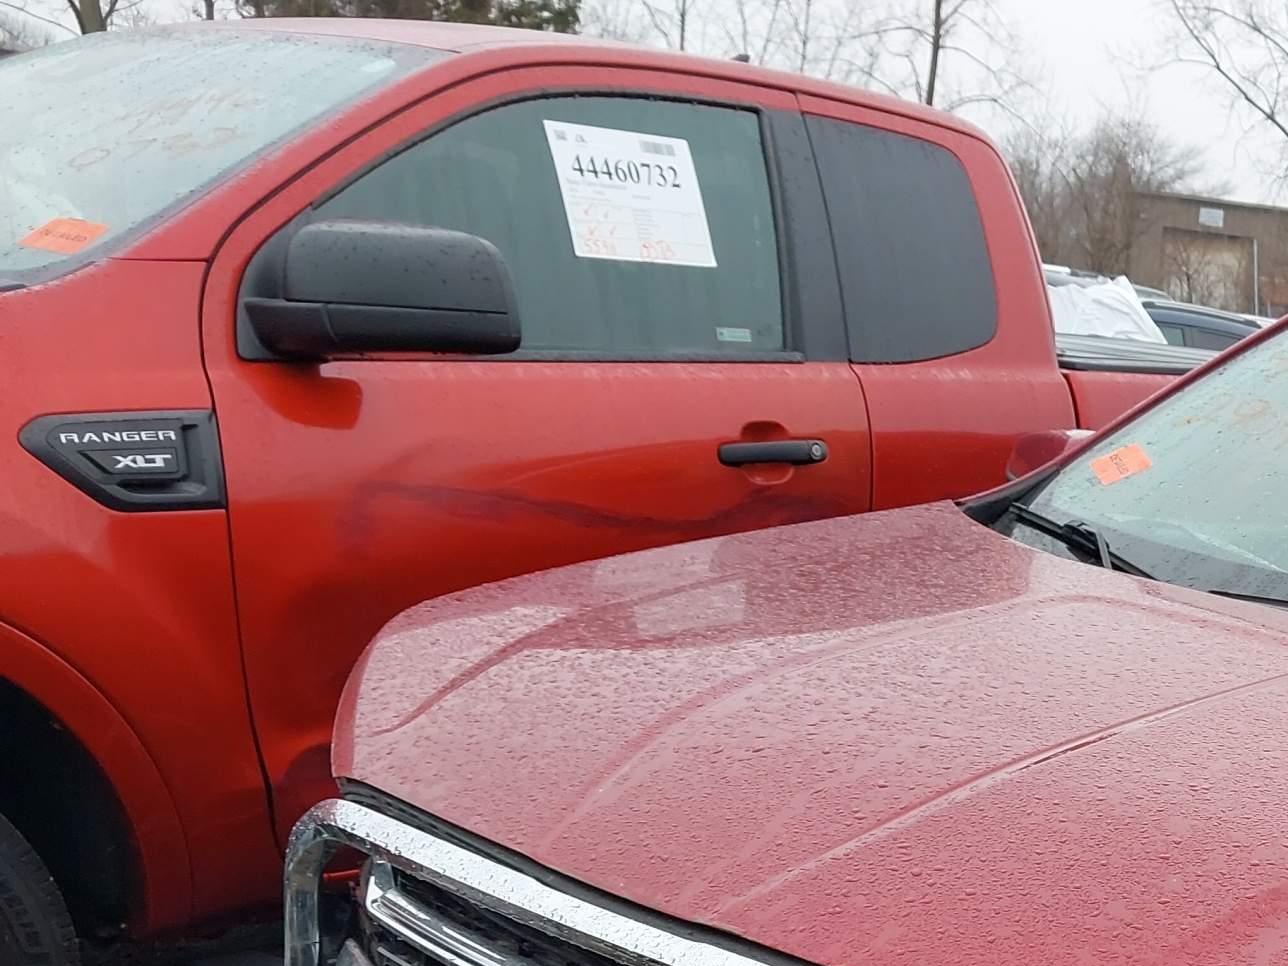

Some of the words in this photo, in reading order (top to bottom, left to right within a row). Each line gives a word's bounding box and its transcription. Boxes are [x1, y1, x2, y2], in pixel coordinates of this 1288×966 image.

[571, 153, 681, 189] 44460732
[59, 430, 177, 444] RANGER
[112, 454, 172, 469] XLT
